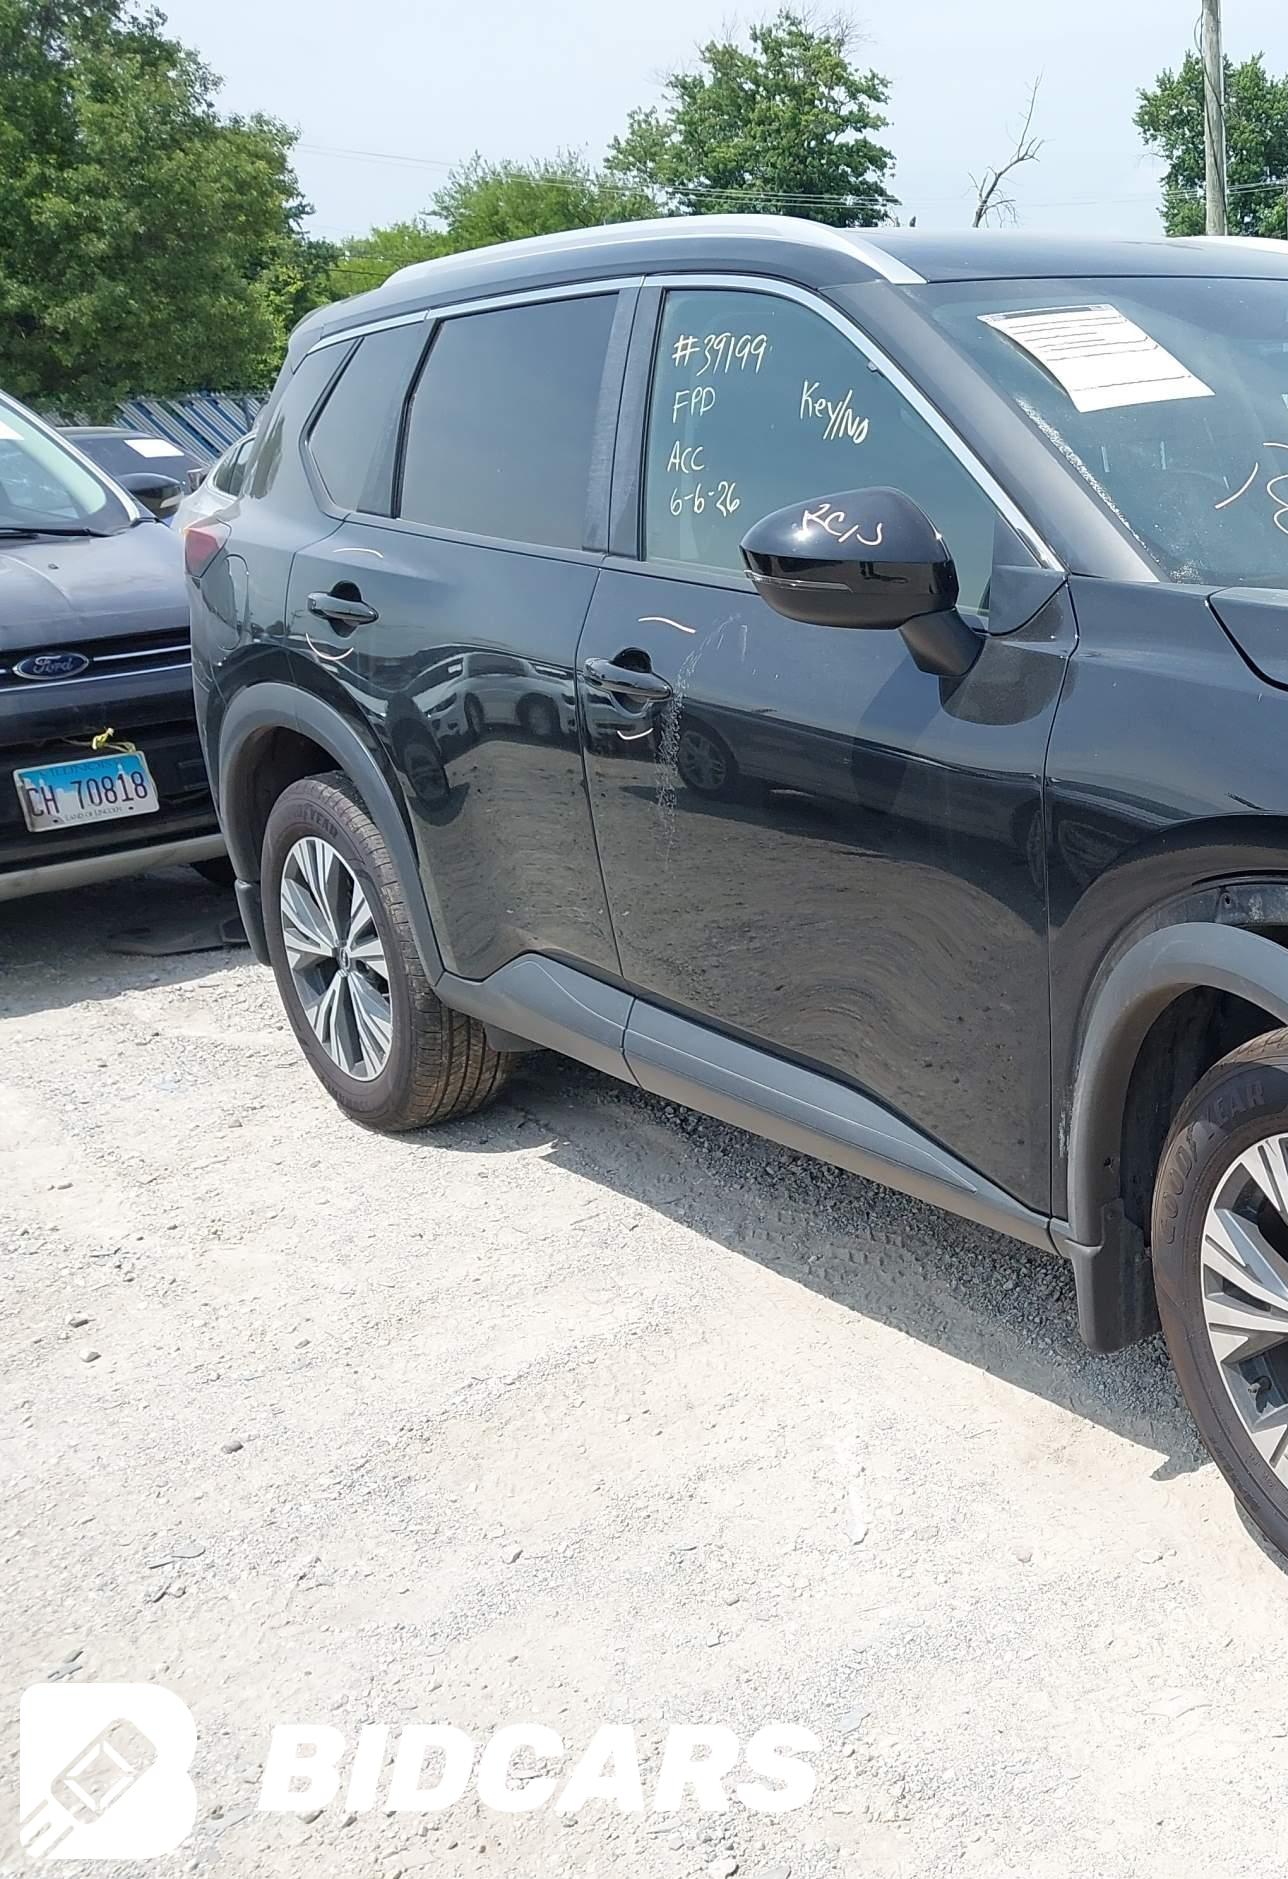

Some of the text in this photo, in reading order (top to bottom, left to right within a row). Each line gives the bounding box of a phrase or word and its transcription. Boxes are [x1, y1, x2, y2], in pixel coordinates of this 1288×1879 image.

[672, 333, 768, 377] #39199
[672, 386, 716, 424] FPD
[667, 440, 705, 474] ACC
[33, 655, 73, 674] Ford
[26, 771, 148, 817] CH 70818
